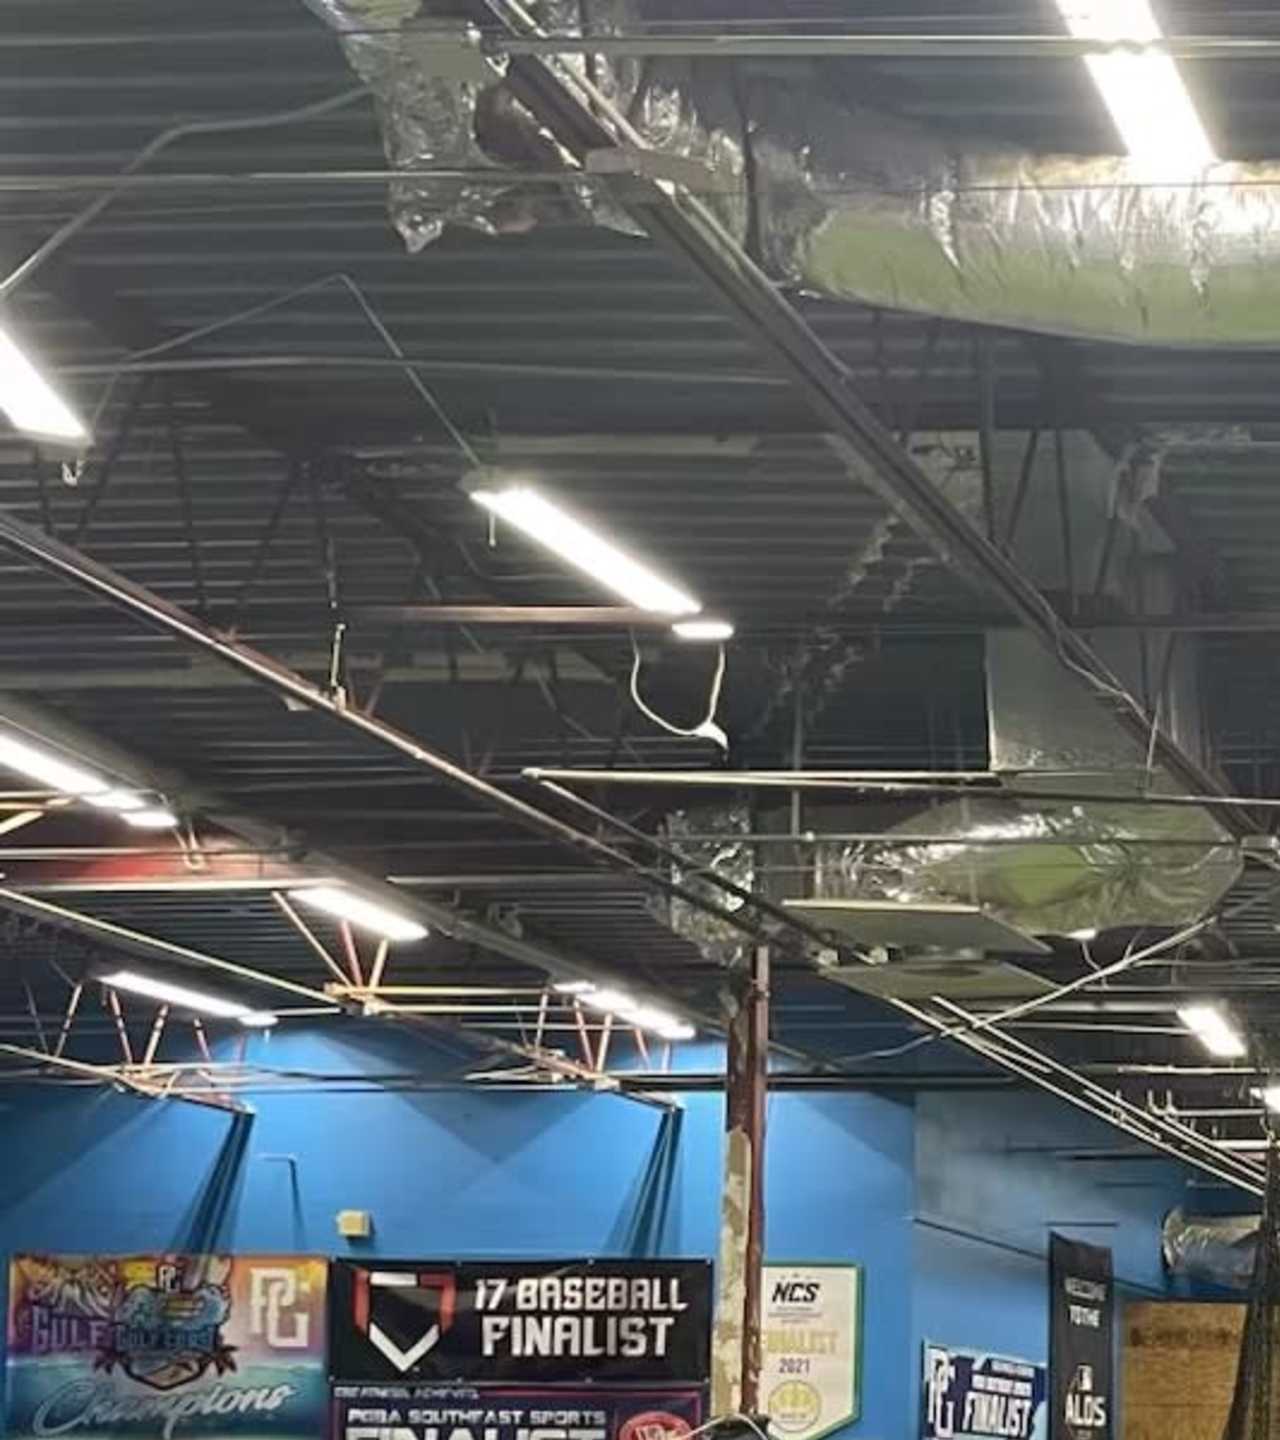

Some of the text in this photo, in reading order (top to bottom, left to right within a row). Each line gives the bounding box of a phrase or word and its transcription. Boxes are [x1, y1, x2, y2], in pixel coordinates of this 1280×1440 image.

[248, 1267, 311, 1348] PG
[516, 1276, 689, 1312] BASEBALL
[772, 1282, 820, 1303] NCS
[481, 1316, 675, 1357] FINALIST
[779, 1357, 810, 1374] 2021
[33, 1381, 296, 1440] Champions
[926, 1348, 956, 1438] PG
[1064, 1392, 1107, 1427] ALDS
[529, 1409, 606, 1425] SPORTS
[962, 1391, 1033, 1438] FINALIST
